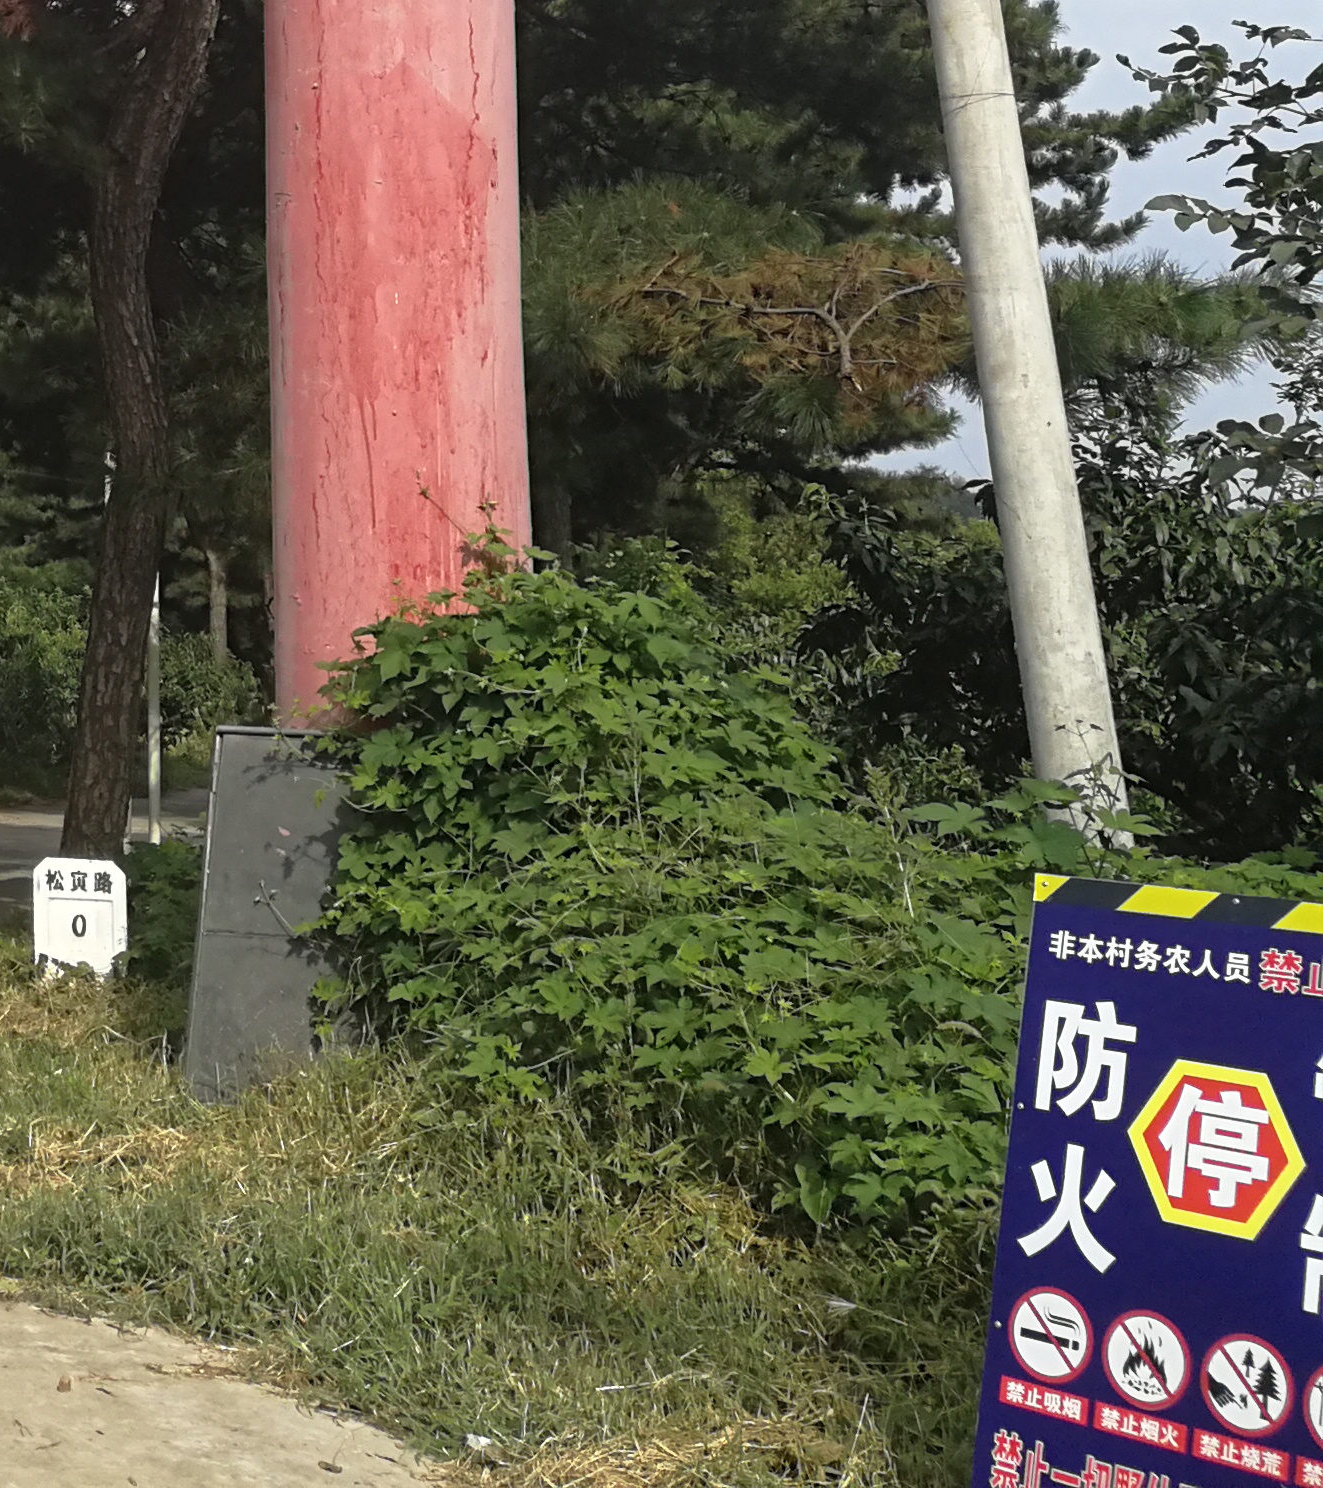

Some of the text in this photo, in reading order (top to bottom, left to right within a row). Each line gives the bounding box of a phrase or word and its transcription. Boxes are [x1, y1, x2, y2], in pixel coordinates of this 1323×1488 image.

[71, 914, 87, 937] 0
[1017, 1000, 1136, 1274] 防火
[1158, 1084, 1270, 1208] 停
[1006, 1380, 1082, 1421] 禁止吸烟
[1101, 1407, 1180, 1448] 禁止烟火
[1200, 1434, 1283, 1476] 禁止烧荒
